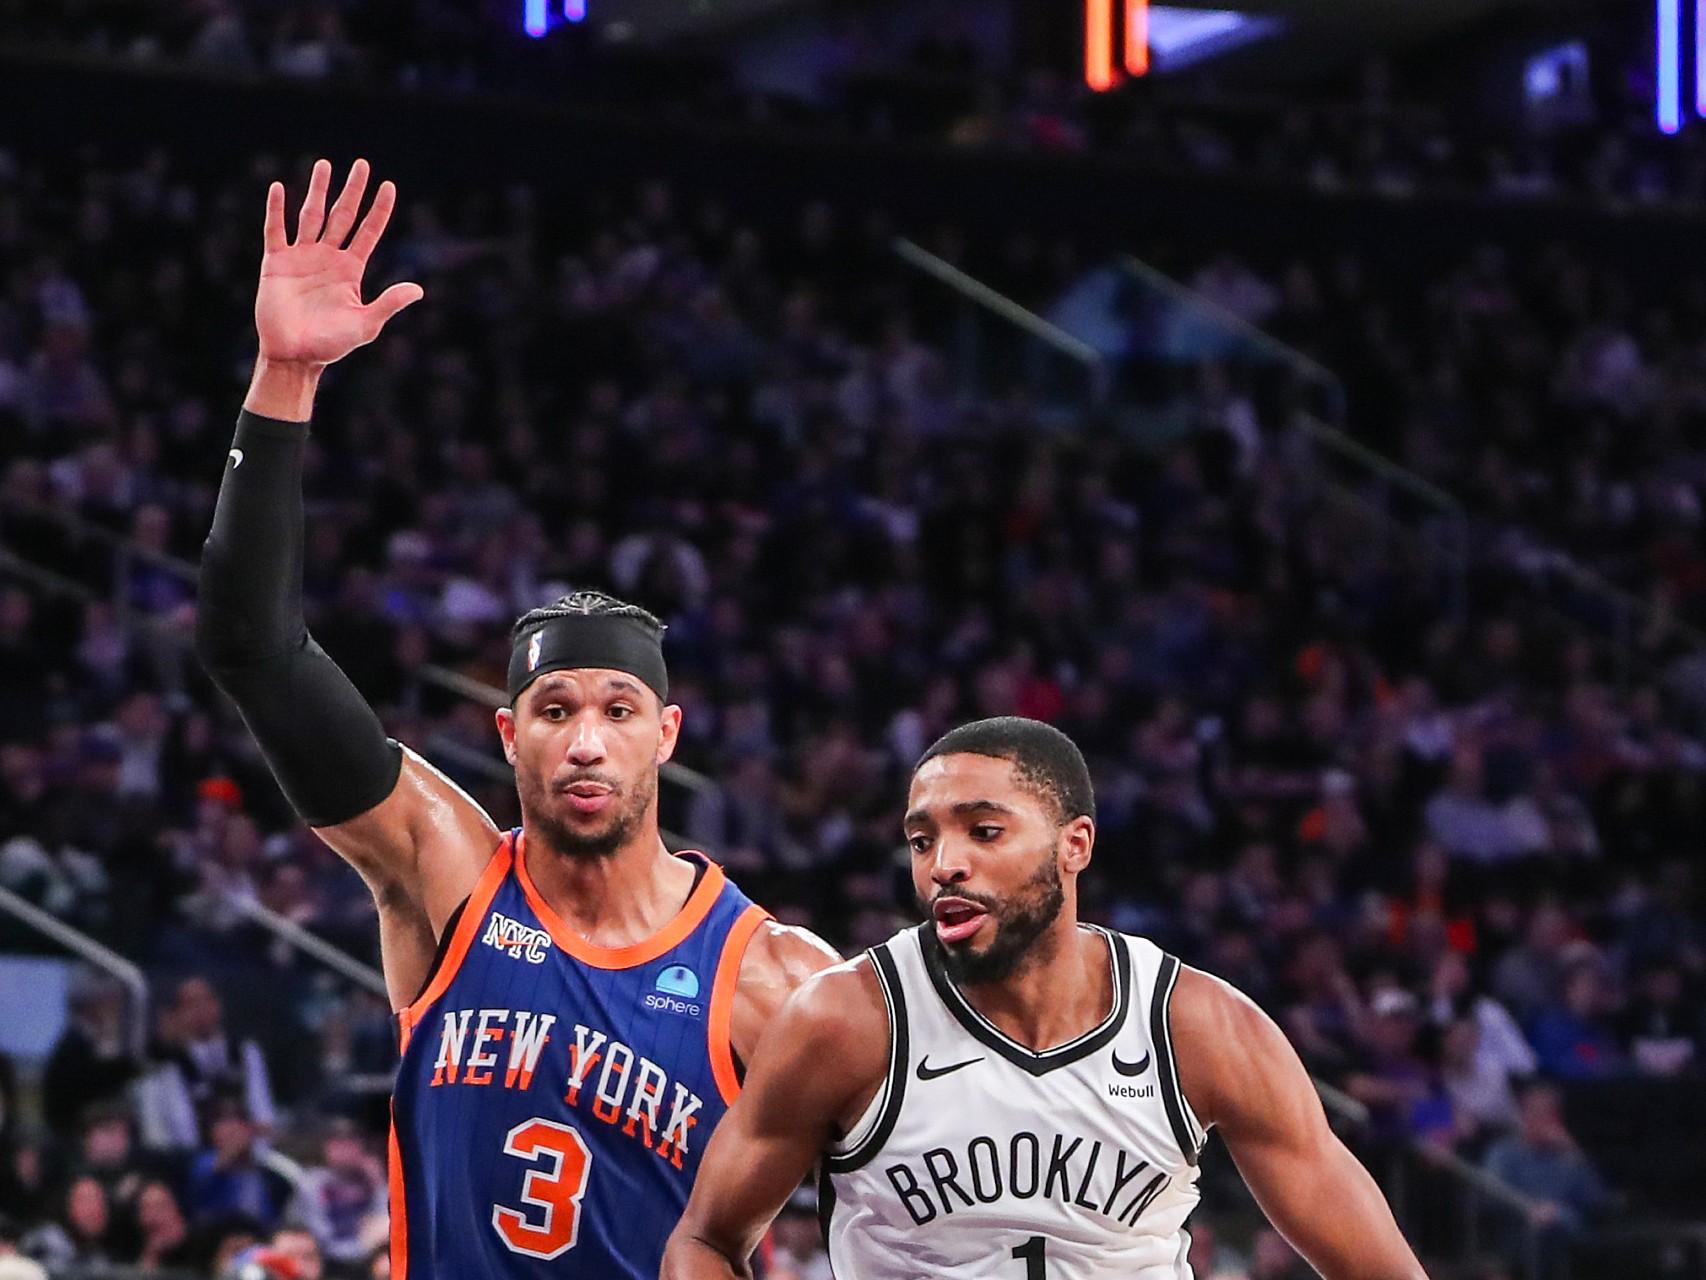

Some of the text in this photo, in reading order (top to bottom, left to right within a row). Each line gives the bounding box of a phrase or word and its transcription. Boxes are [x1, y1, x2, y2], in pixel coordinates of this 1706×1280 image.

[482, 912, 551, 964] NYC
[645, 993, 701, 1017] sphere
[431, 1009, 703, 1170] NEW YORK
[1108, 1084, 1154, 1098] Webull
[492, 1117, 593, 1261] 3
[885, 1132, 1172, 1228] BROOKLYN
